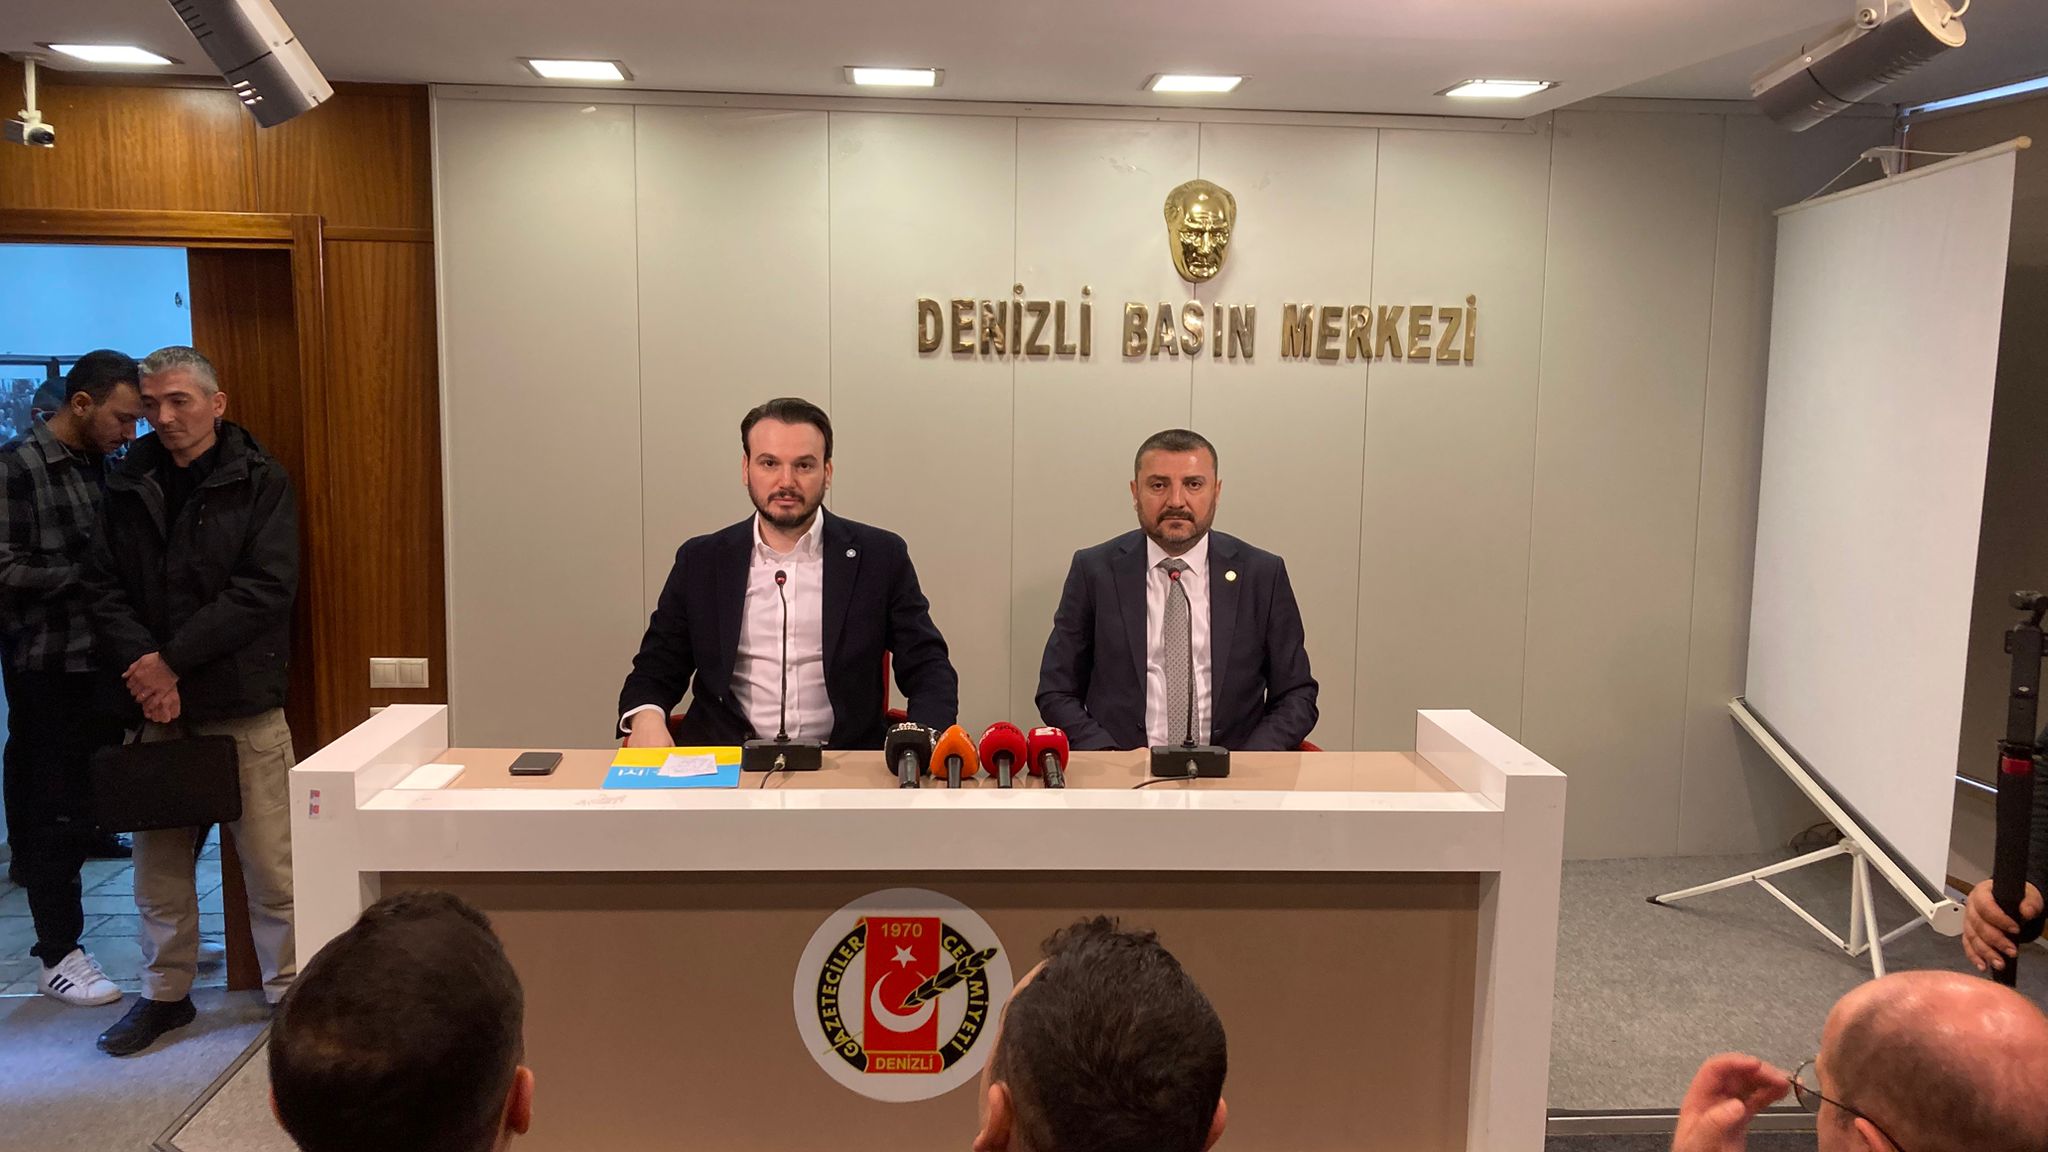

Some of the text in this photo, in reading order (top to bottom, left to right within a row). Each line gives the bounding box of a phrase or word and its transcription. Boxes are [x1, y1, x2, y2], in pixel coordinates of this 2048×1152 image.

[917, 283, 1477, 361] DENİZLİ BASIN MERKEZİ
[881, 923, 923, 938] 1970
[821, 935, 865, 1058] GAZETECİLER
[875, 1054, 934, 1071] DENİZLİ
